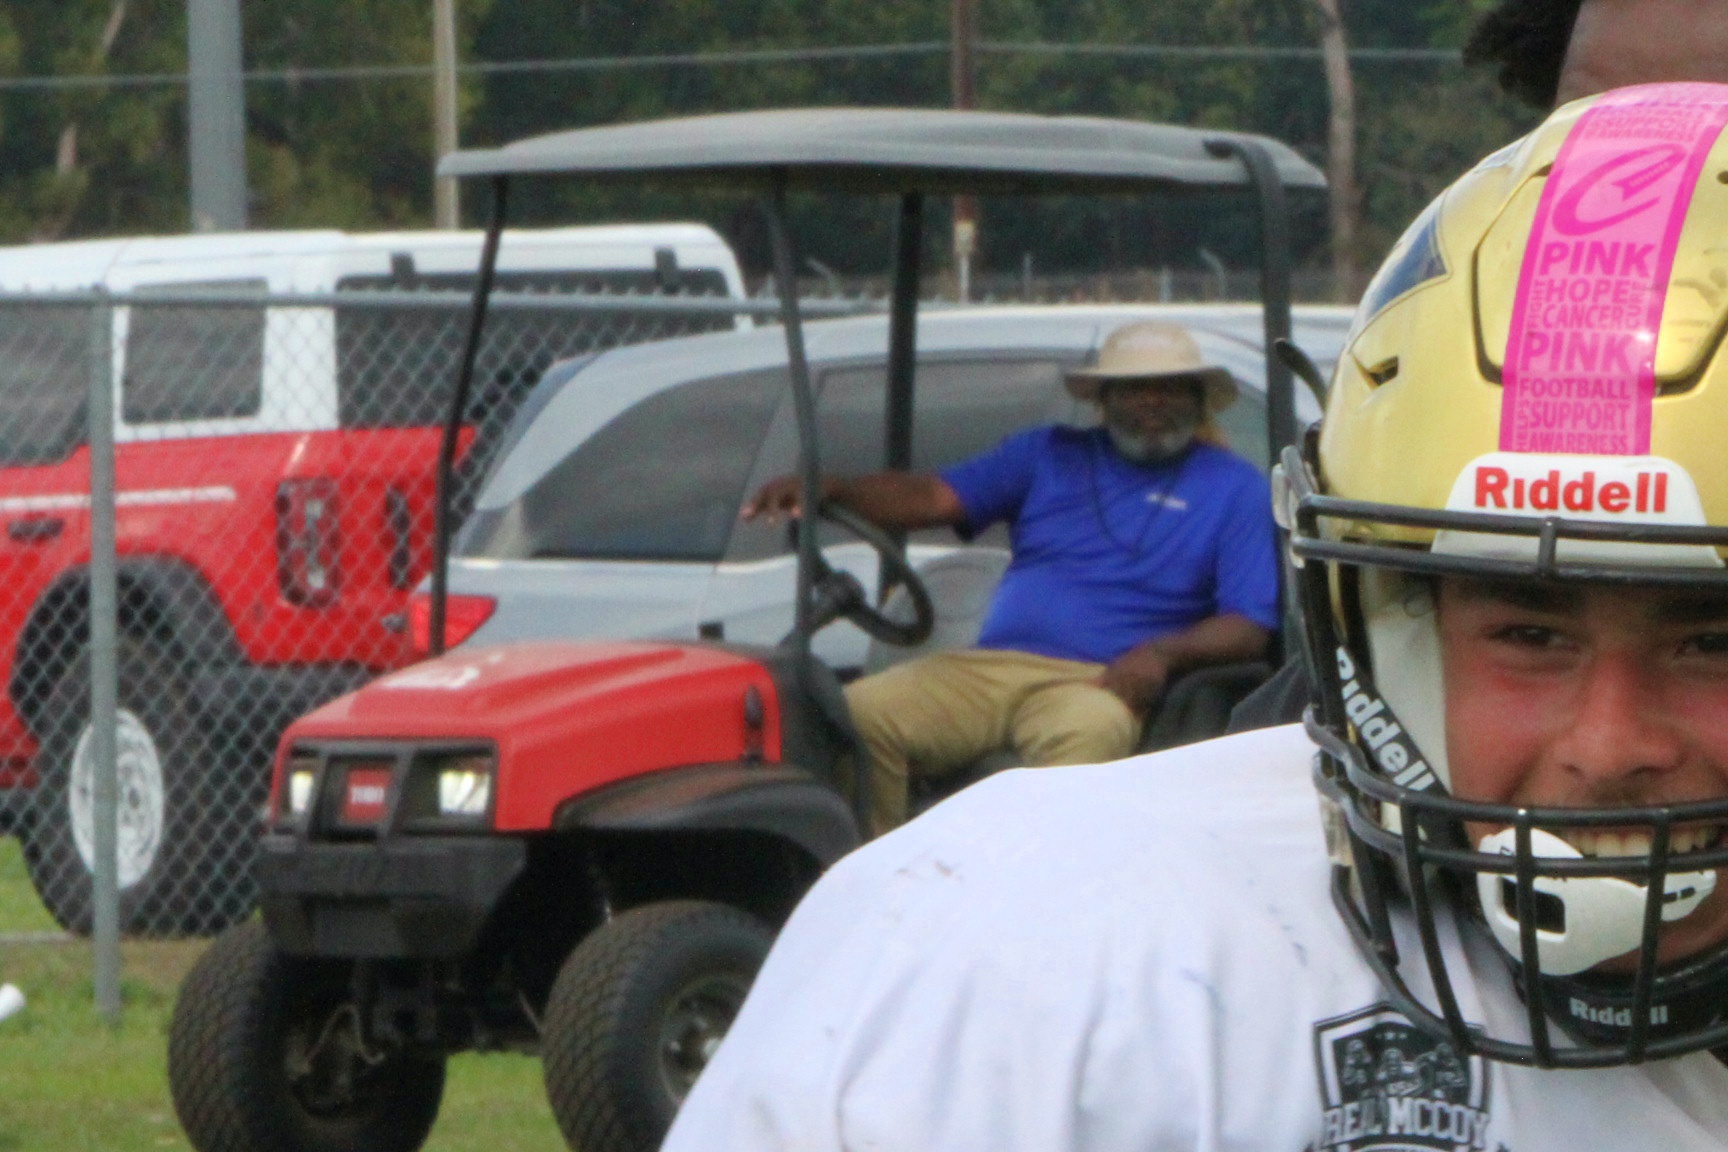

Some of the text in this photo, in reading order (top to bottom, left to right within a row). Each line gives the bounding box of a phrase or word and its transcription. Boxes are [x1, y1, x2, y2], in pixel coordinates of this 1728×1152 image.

[1539, 240, 1655, 278] PINK
[1546, 278, 1630, 304] HOPE
[1542, 303, 1624, 330] CANCER
[1521, 331, 1635, 372] PINK
[1519, 376, 1631, 399] FOOTBALL
[1529, 400, 1631, 431] SUPPORT
[1528, 432, 1629, 455] AWARENESS
[1475, 466, 1668, 513] Riddell
[1569, 997, 1669, 1027] Riddll
[1321, 1096, 1489, 1149] REL MCCOY
